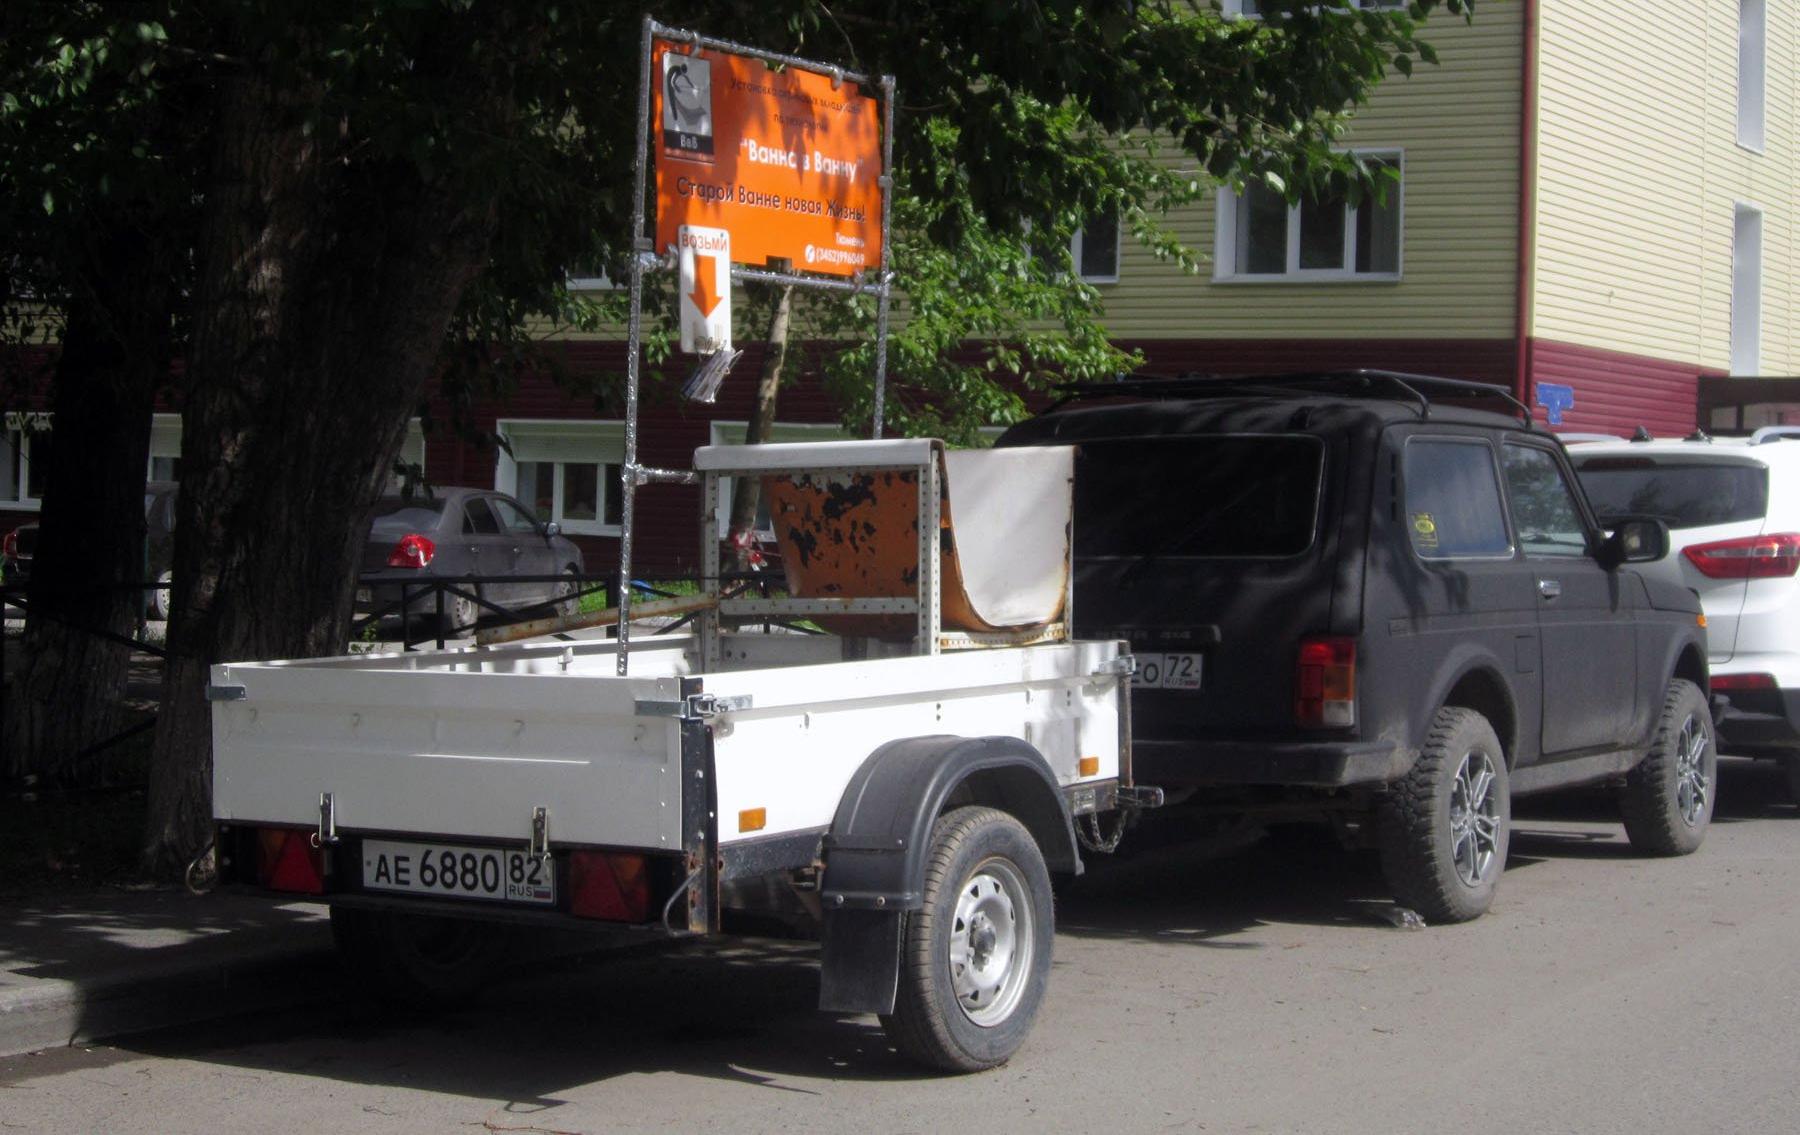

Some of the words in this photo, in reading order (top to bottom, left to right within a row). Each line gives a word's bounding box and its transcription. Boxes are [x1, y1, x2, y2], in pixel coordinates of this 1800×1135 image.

[676, 176, 734, 202] Старой
[738, 186, 781, 208] Ванне
[785, 197, 822, 215] новая
[682, 233, 728, 251] ВОЗЬМИ
[1167, 656, 1194, 677] 72
[509, 853, 542, 886] 82
[509, 885, 533, 897] RUS
